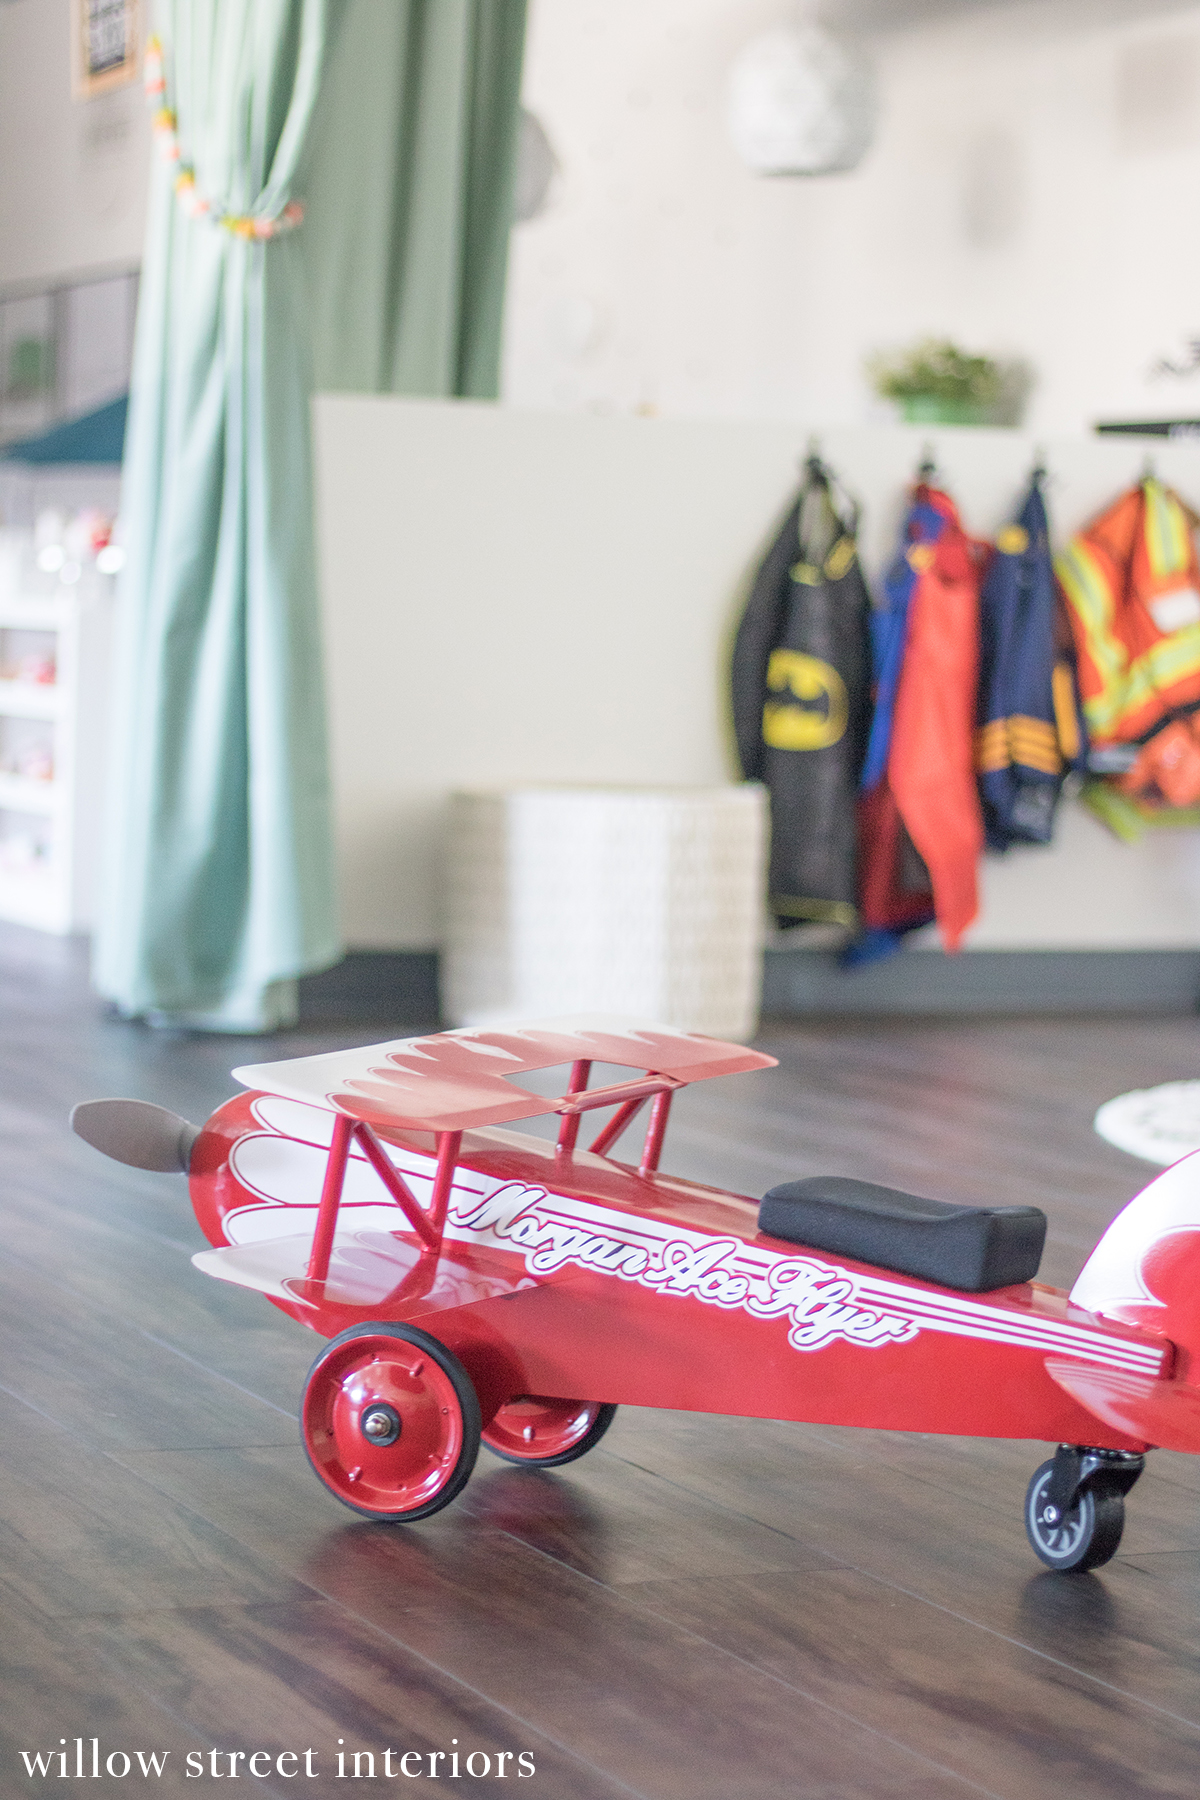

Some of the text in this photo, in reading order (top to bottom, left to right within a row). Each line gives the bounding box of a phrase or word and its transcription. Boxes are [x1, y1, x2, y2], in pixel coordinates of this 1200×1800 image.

[447, 1182, 917, 1349] Morgan Ace Flyer
